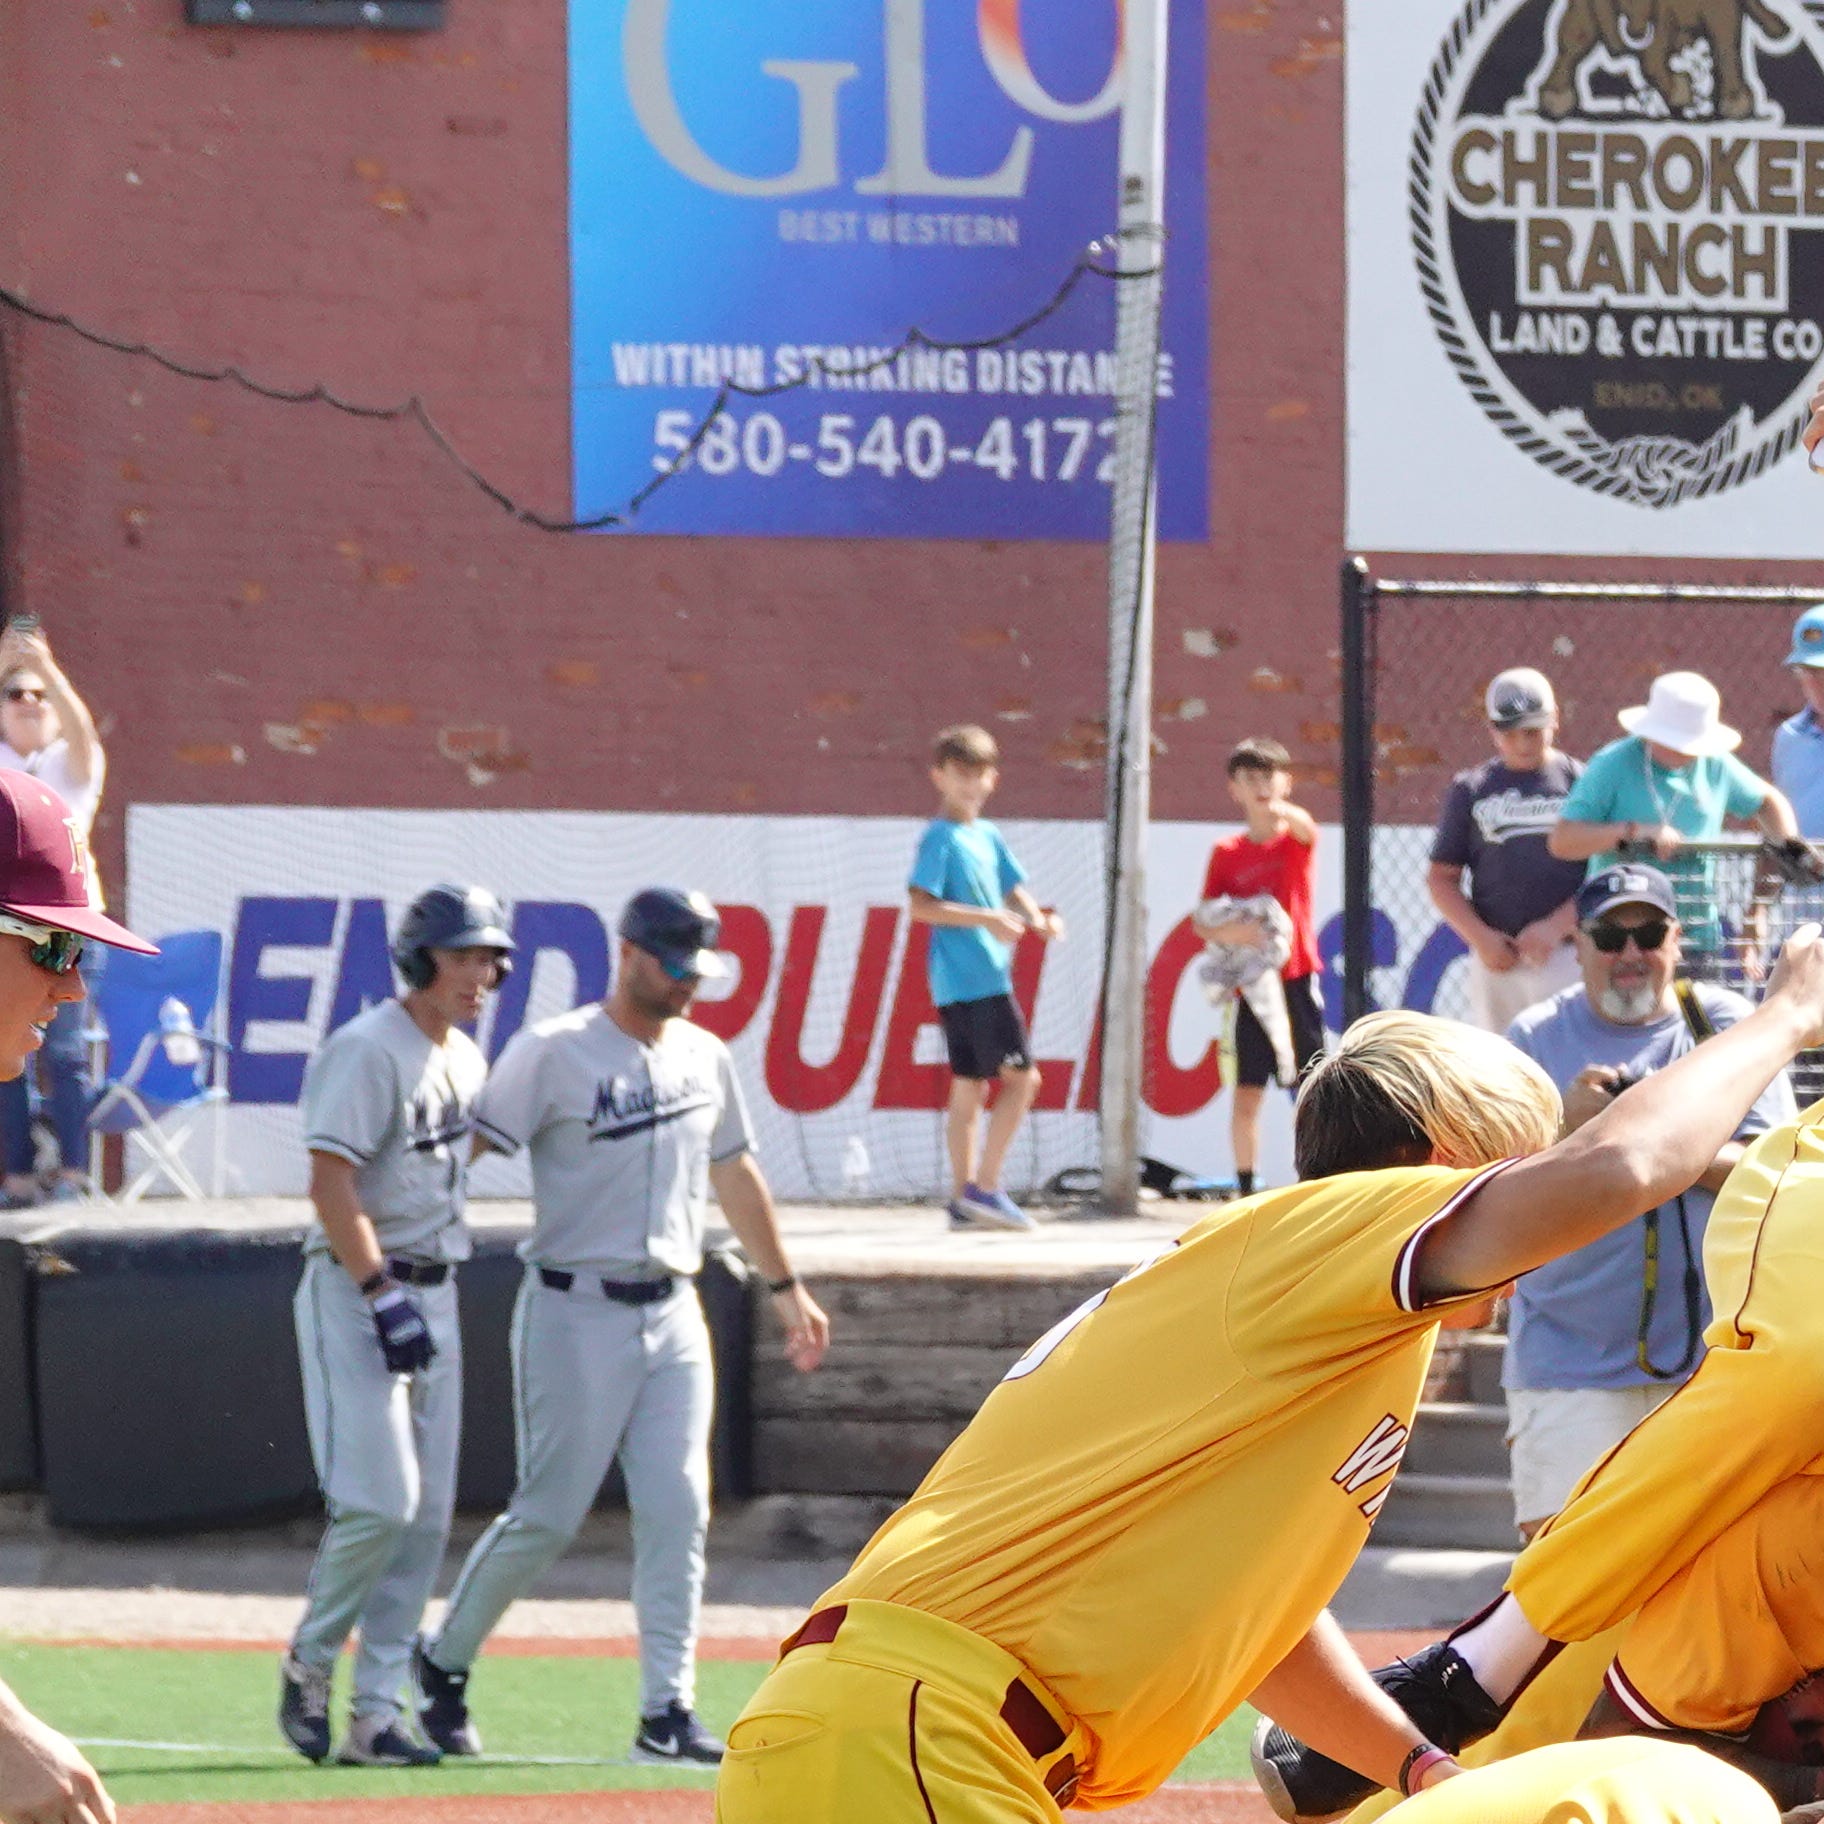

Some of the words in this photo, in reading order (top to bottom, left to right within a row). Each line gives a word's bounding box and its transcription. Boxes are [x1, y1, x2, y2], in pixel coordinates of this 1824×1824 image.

[778, 210, 857, 243] BEST
[868, 212, 1019, 246] WESTERN
[1525, 217, 1779, 301] RANCH
[1490, 312, 1591, 355] LAND
[1598, 316, 1622, 356] &
[1633, 318, 1768, 360] CATTLE
[1771, 321, 1823, 361] CO
[611, 342, 762, 389] WITHIN
[774, 345, 968, 394] STRIKING
[977, 349, 1175, 398] DISTANE
[229, 896, 610, 1104] END
[688, 904, 1227, 1117] PULC
